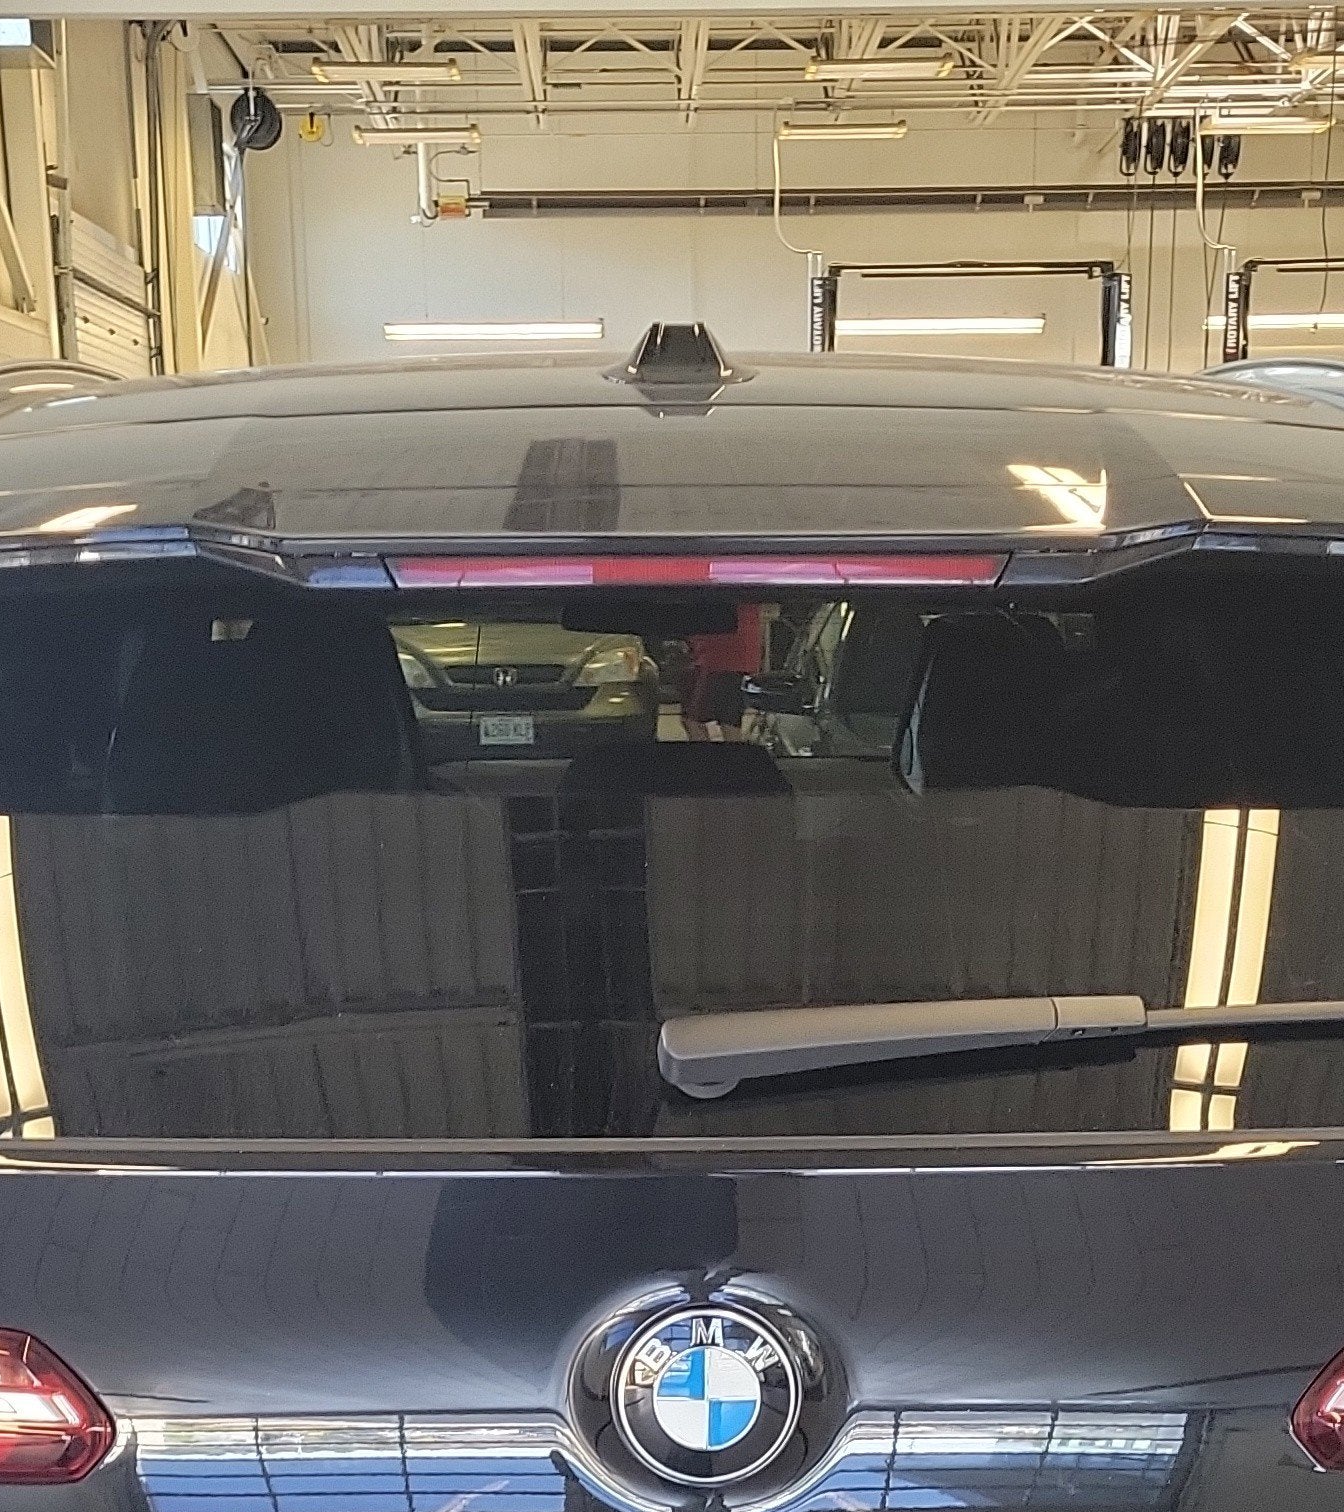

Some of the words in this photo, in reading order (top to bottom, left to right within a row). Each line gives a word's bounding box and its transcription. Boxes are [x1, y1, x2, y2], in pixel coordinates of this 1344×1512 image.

[812, 279, 824, 304] LIFT
[1228, 275, 1240, 299] LIFT
[1226, 301, 1239, 347] ROTARY
[635, 1317, 782, 1381] BMW
